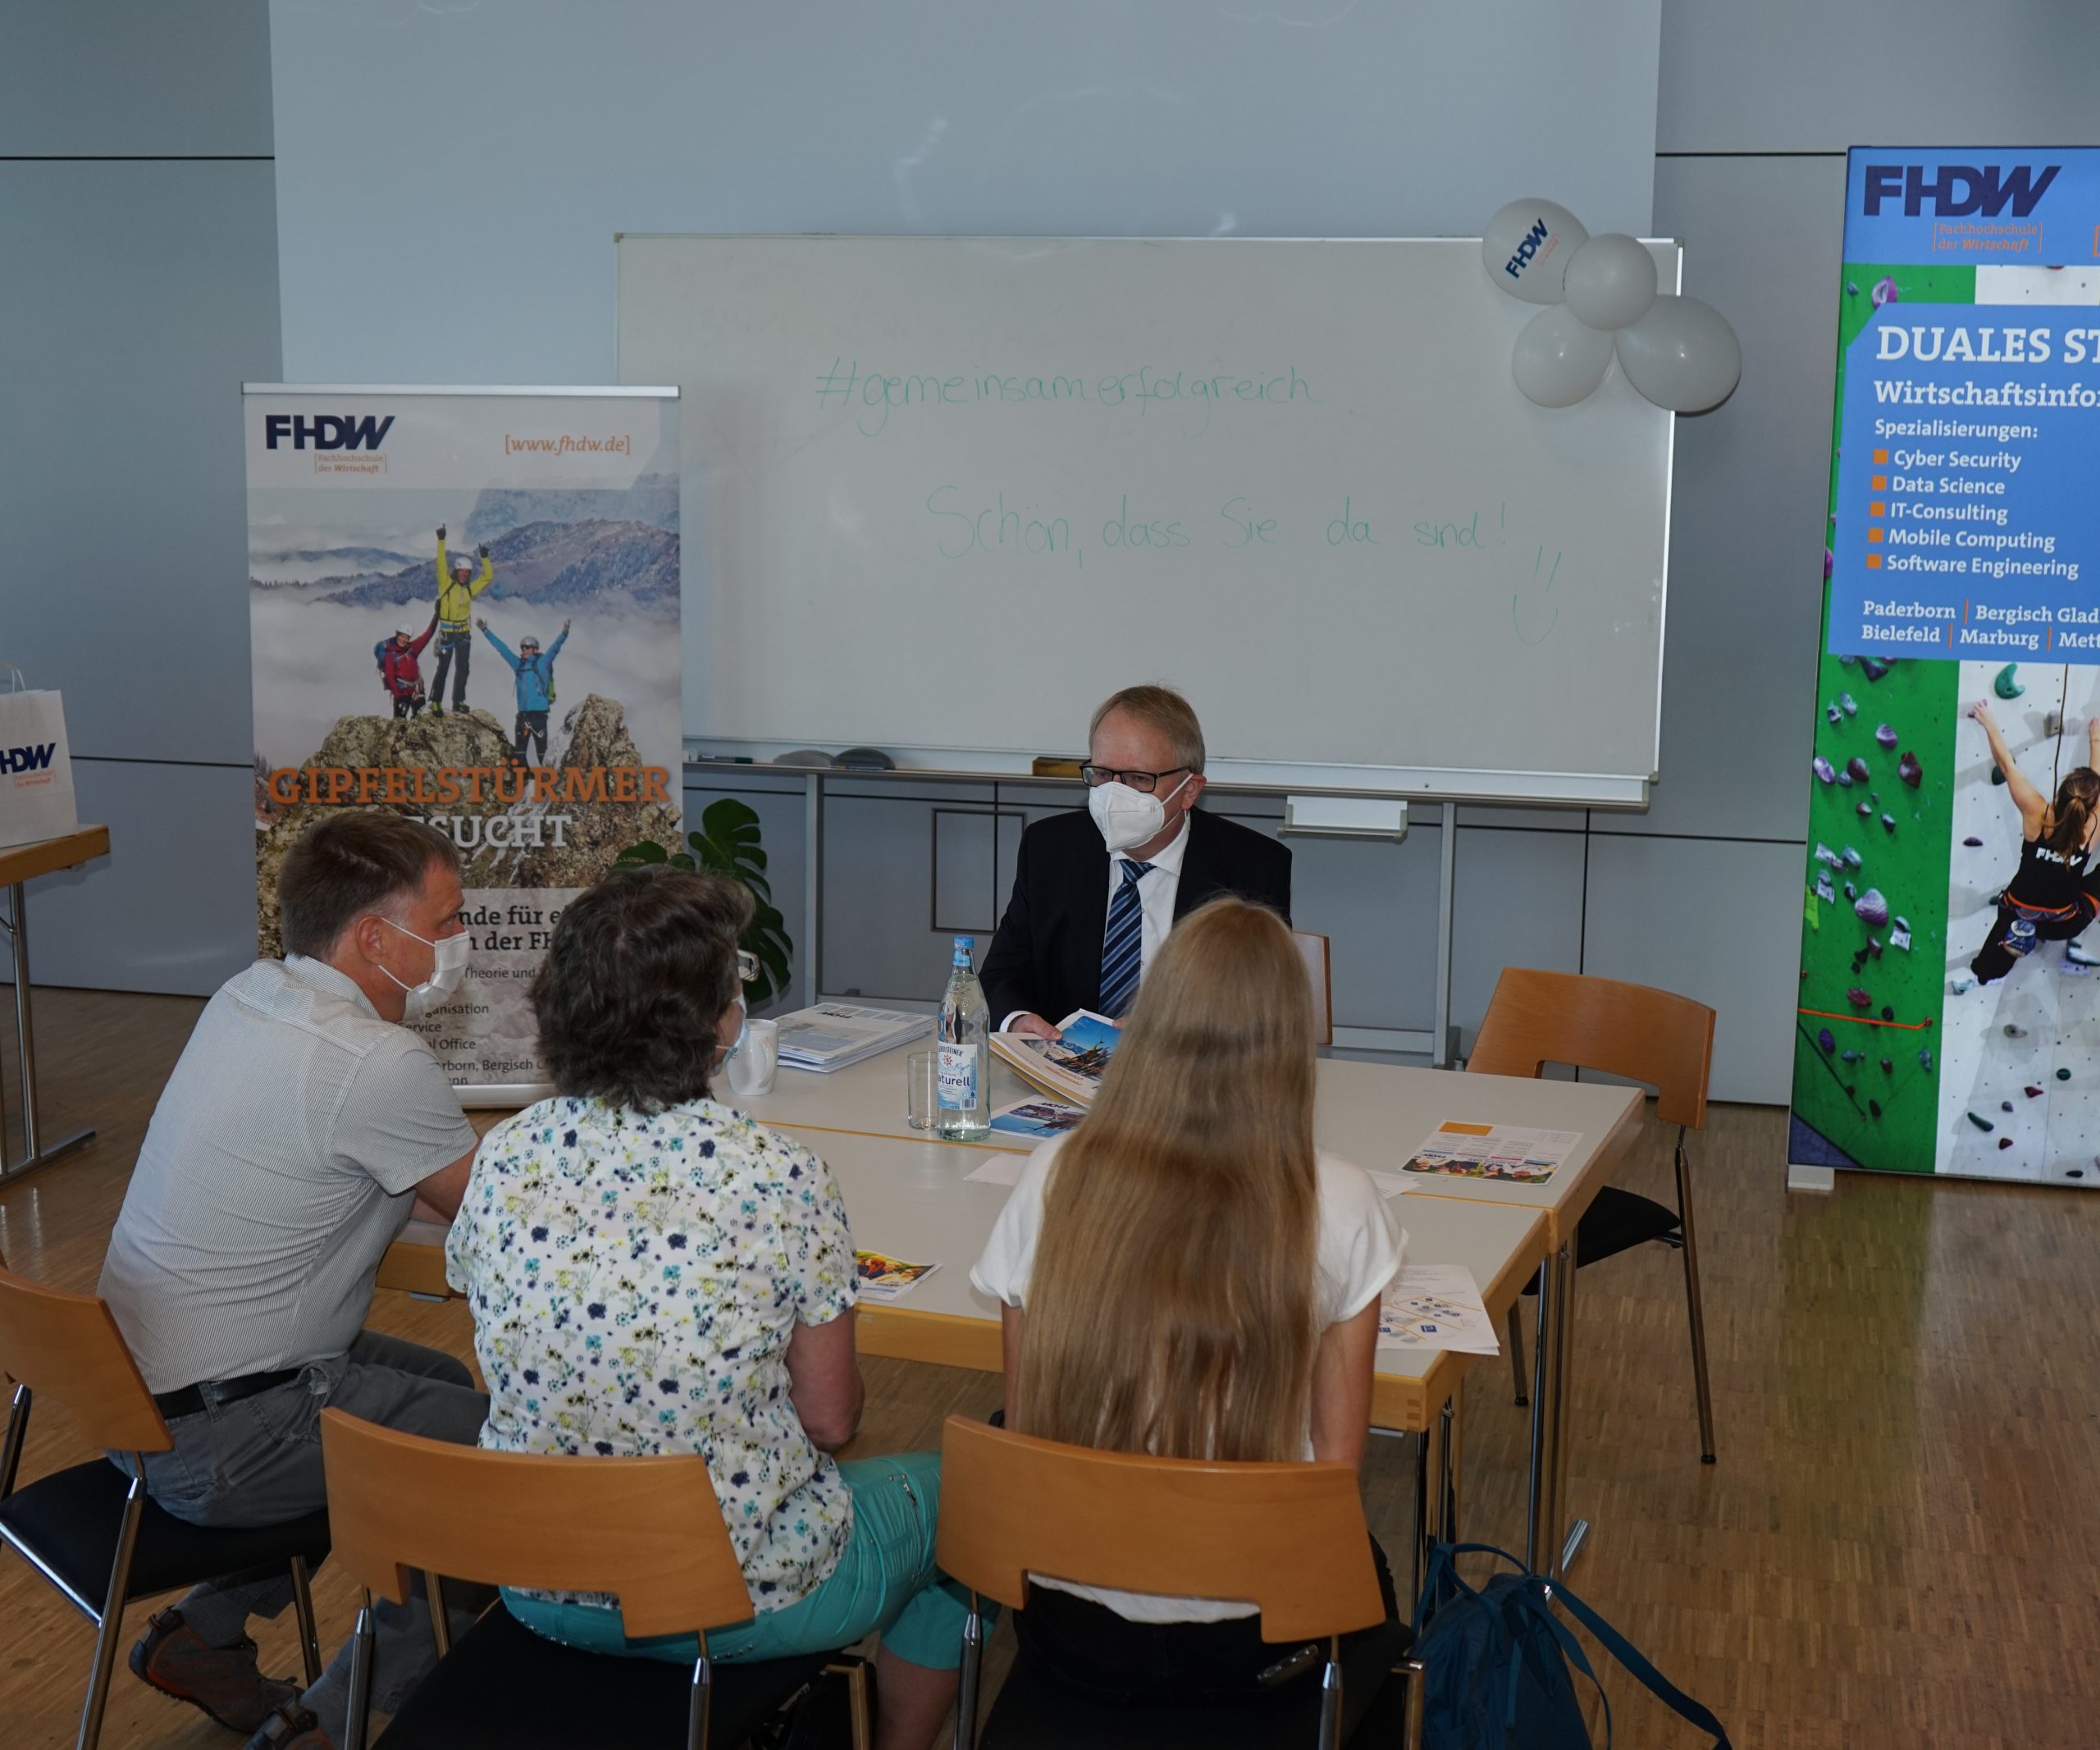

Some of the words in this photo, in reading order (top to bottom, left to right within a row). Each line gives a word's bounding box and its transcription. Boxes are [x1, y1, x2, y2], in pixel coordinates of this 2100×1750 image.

[1864, 165, 2062, 217] FHDW
[1938, 223, 2038, 235] Fachhochschule
[1505, 218, 1549, 279] FHDW
[1938, 240, 1958, 249] der
[1962, 240, 2029, 253] Wirtschaft
[1876, 326, 2050, 363] DUALES
[1874, 380, 2100, 408] Wirtschaftsinfo
[266, 414, 395, 450] FHDW
[1874, 419, 2038, 442] Spezialisierungen:
[504, 434, 631, 455] [www.fhdw.de]
[334, 464, 379, 473] Wirtschaft
[1893, 450, 1945, 470] Cyber
[1949, 451, 2022, 473] Security
[1892, 476, 1934, 493] Data
[1939, 477, 2006, 495] Science
[1891, 502, 2008, 525] IT-Consulting
[928, 485, 1083, 569] Schön,
[1103, 494, 1190, 548] dass
[1221, 497, 1278, 548] Sie
[1327, 496, 1381, 546] da
[1888, 529, 1952, 546] Mobile
[1956, 531, 2056, 554] Computing
[1887, 555, 1967, 573] Software
[1971, 557, 2079, 580] Engineering
[1863, 600, 1956, 619] Paderborn
[1975, 605, 2052, 625] Bergisch
[1861, 624, 1941, 643] Bielefeld
[1960, 628, 2040, 650] Marburg
[267, 759, 672, 805] GIPFELSTÜRMER
[404, 815, 573, 848] SUCHT
[507, 906, 543, 925] für
[485, 931, 523, 950] der
[513, 968, 536, 979] und
[439, 1039, 476, 1049] Office
[482, 1059, 533, 1073] Bergisch
